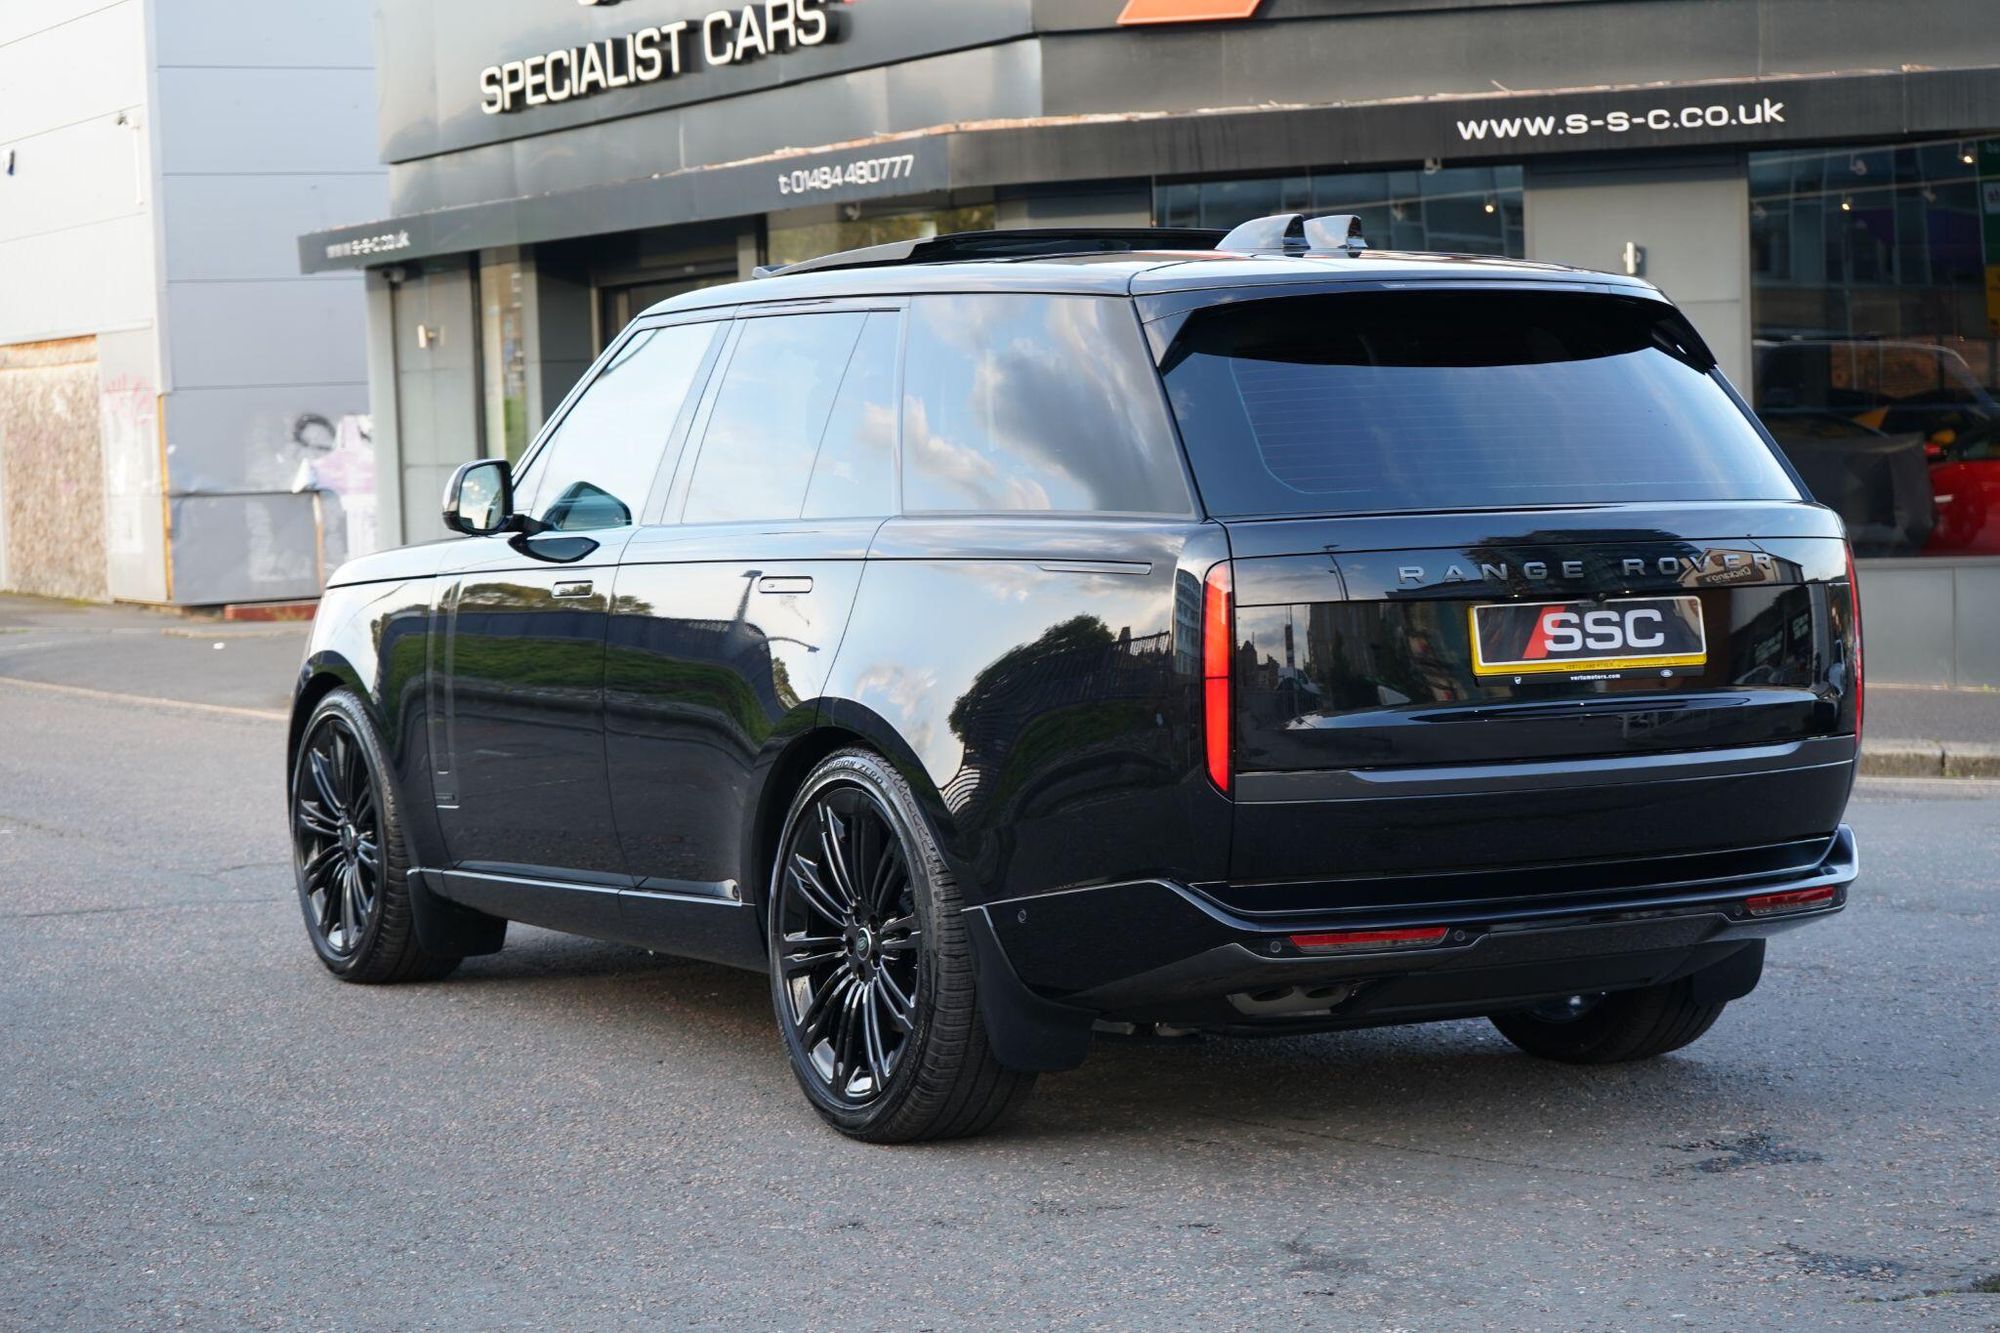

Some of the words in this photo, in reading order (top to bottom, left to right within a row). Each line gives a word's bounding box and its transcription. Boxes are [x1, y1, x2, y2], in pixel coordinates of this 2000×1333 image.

[480, 20, 687, 114] SPECIALIST
[703, 0, 827, 65] CARS
[1457, 98, 1785, 140] www.s-s-c.co.uk
[1398, 560, 1585, 584] RANGE
[1622, 553, 1773, 577] ROVER
[1542, 608, 1664, 652] SSC
